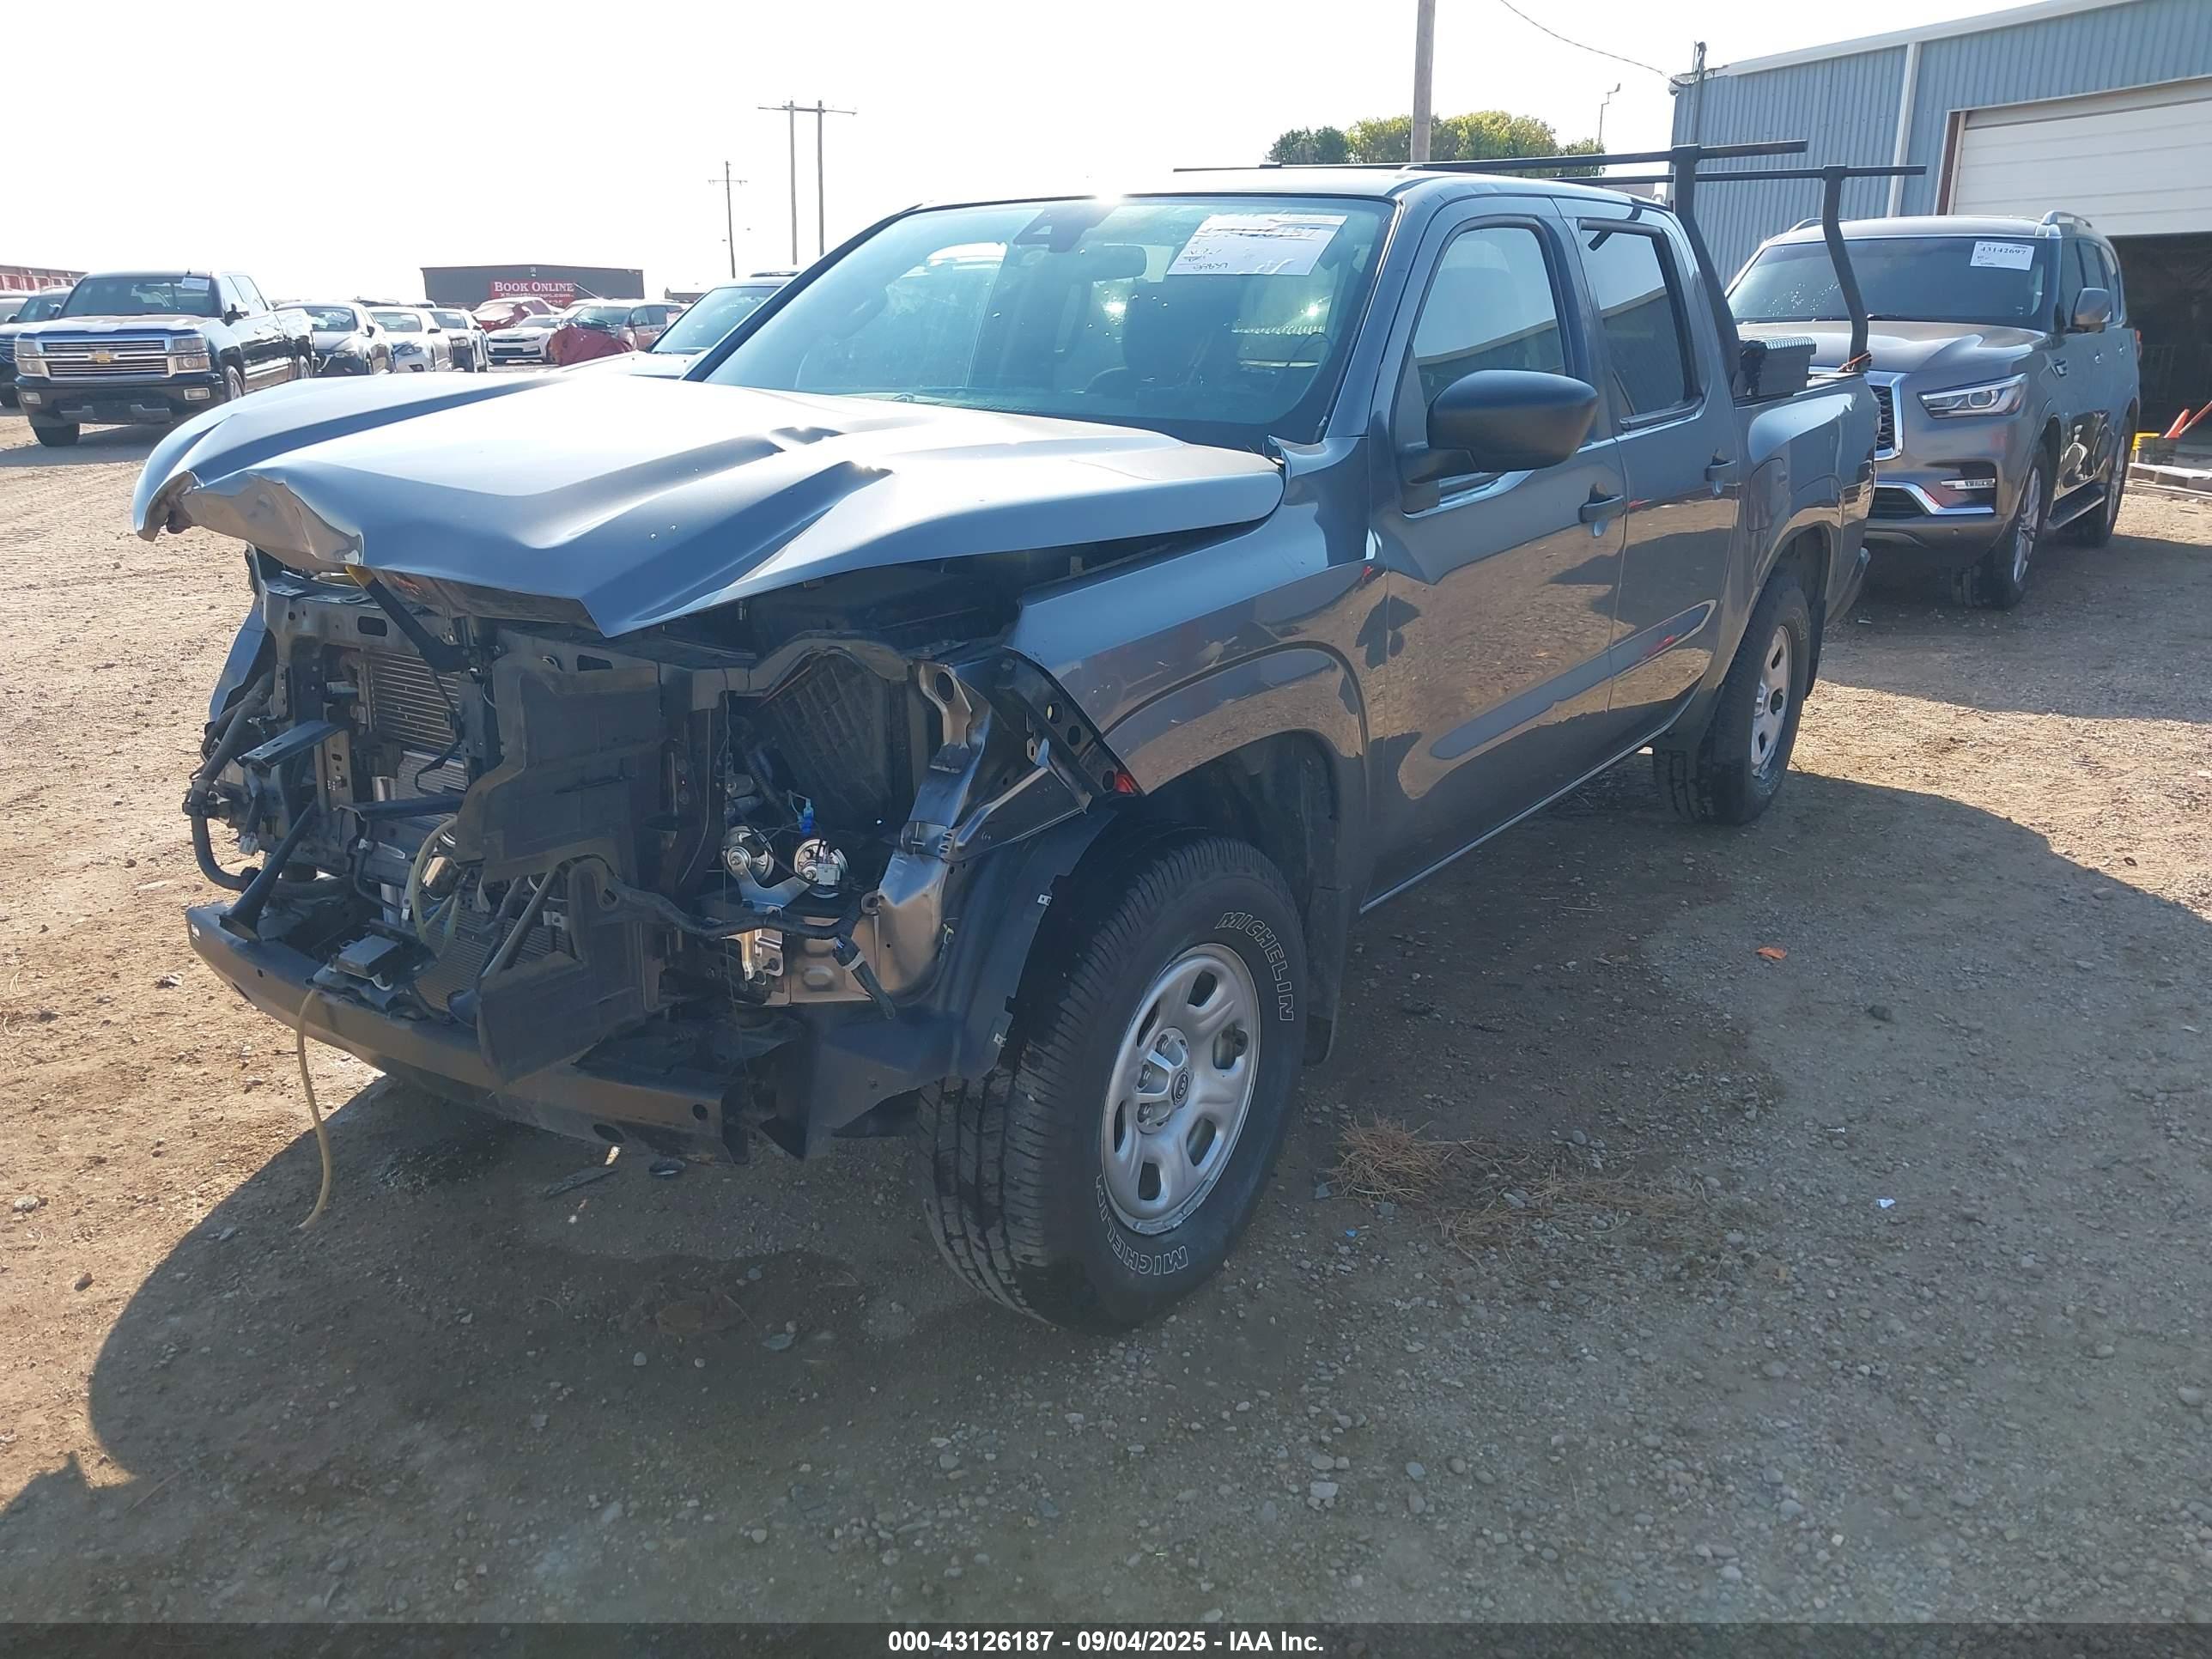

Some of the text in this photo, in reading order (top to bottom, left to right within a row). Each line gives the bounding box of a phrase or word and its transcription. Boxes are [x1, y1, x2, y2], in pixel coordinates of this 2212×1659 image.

[494, 282, 574, 292] BOOK ONLINE
[1214, 912, 1294, 1021] MICHELIN
[1096, 1174, 1188, 1275] MICHELIN
